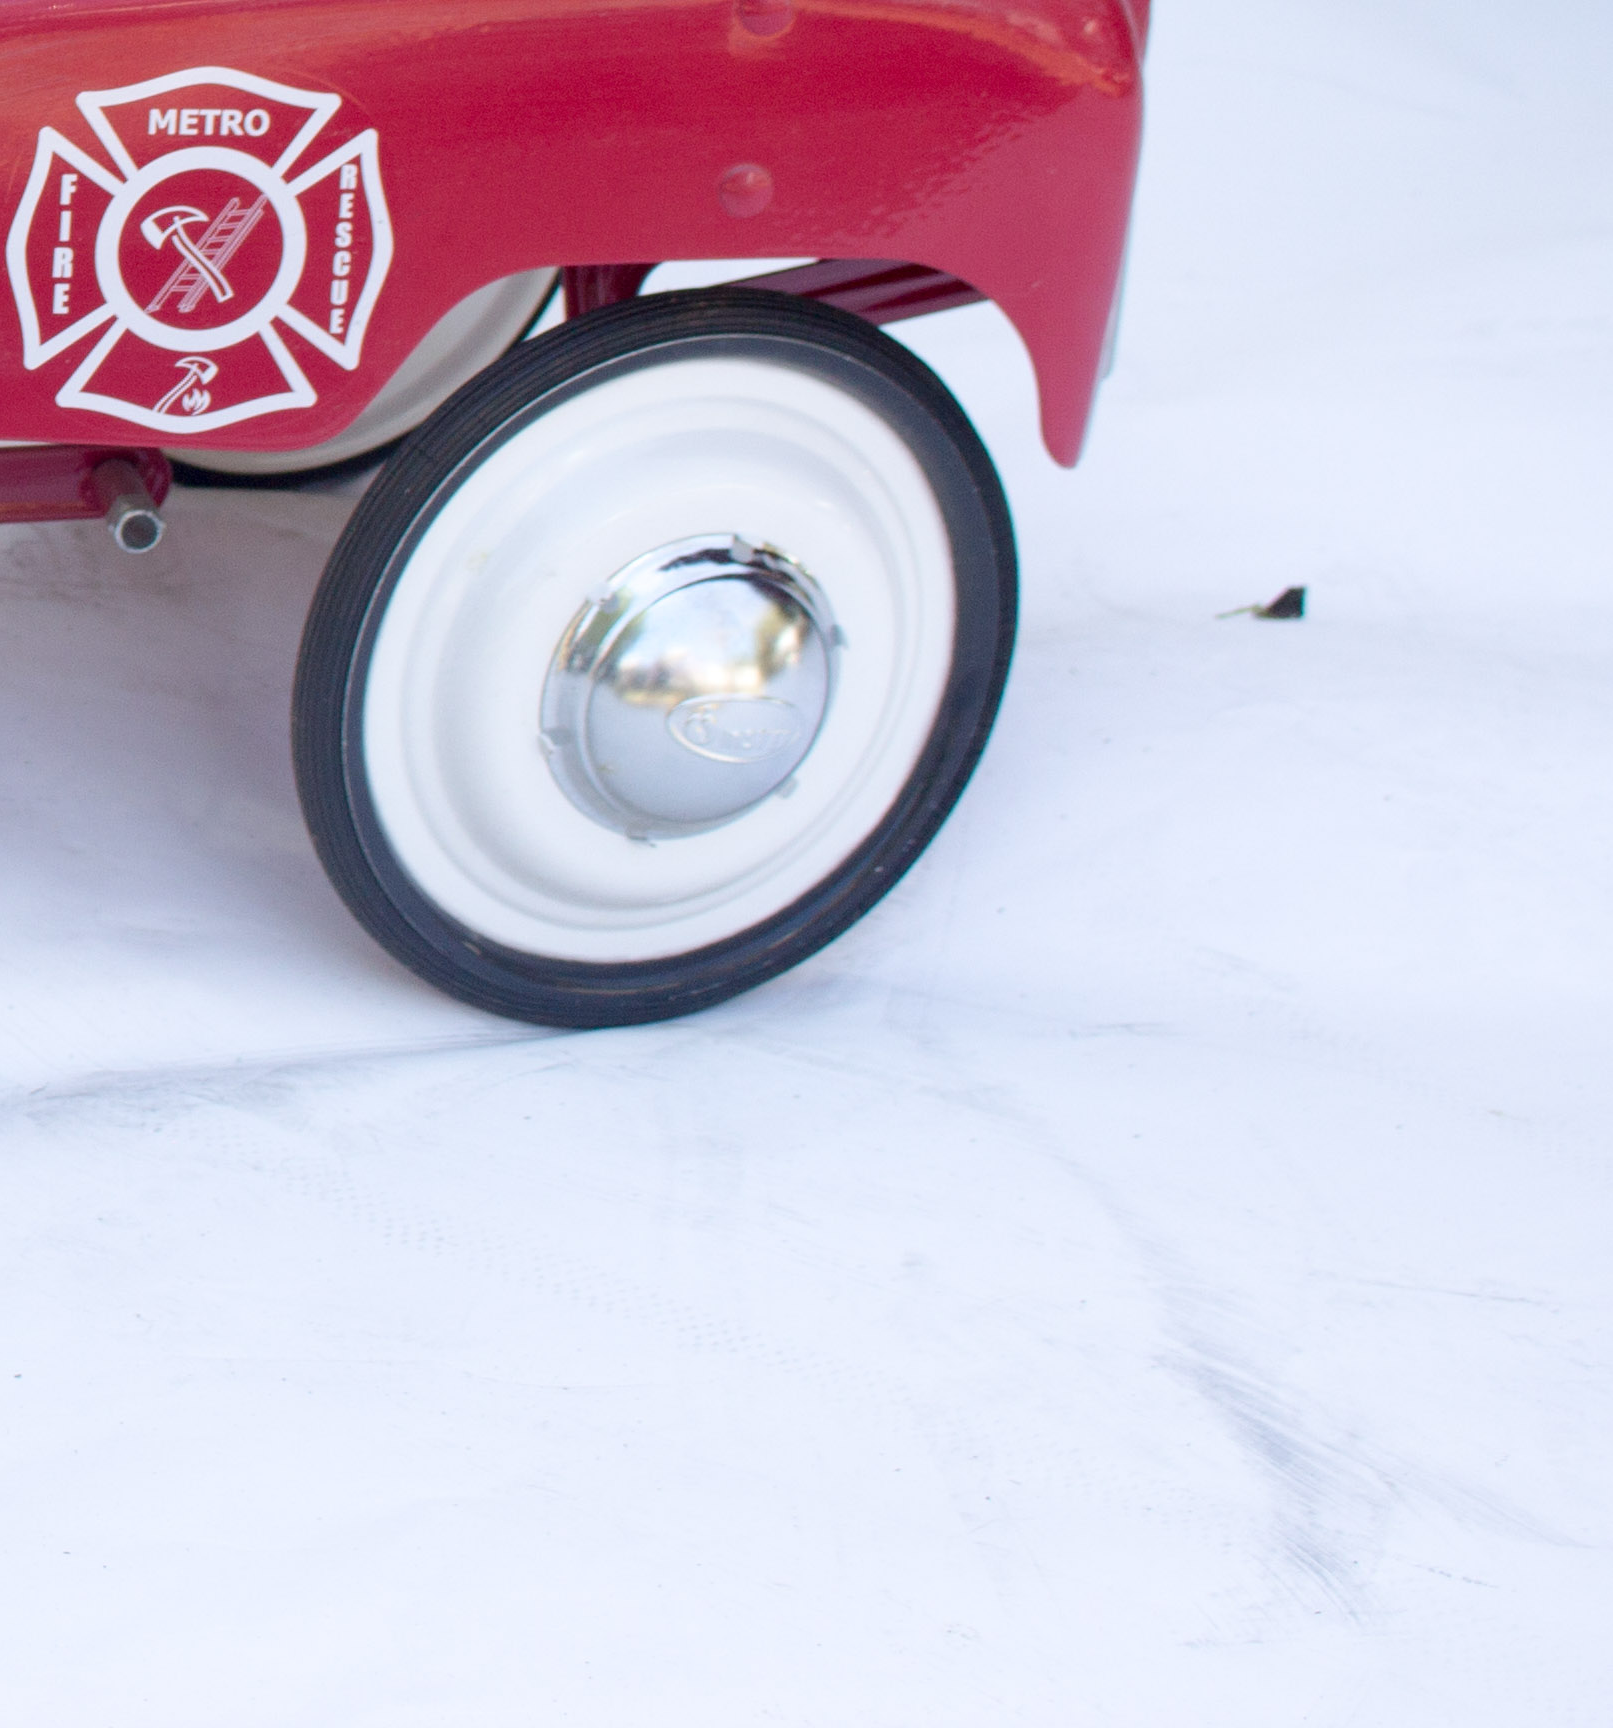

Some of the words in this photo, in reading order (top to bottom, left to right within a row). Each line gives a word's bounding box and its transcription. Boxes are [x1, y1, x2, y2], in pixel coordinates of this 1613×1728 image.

[147, 108, 271, 138] METRO
[51, 173, 78, 315] FIRE
[329, 164, 358, 334] RESCUE
